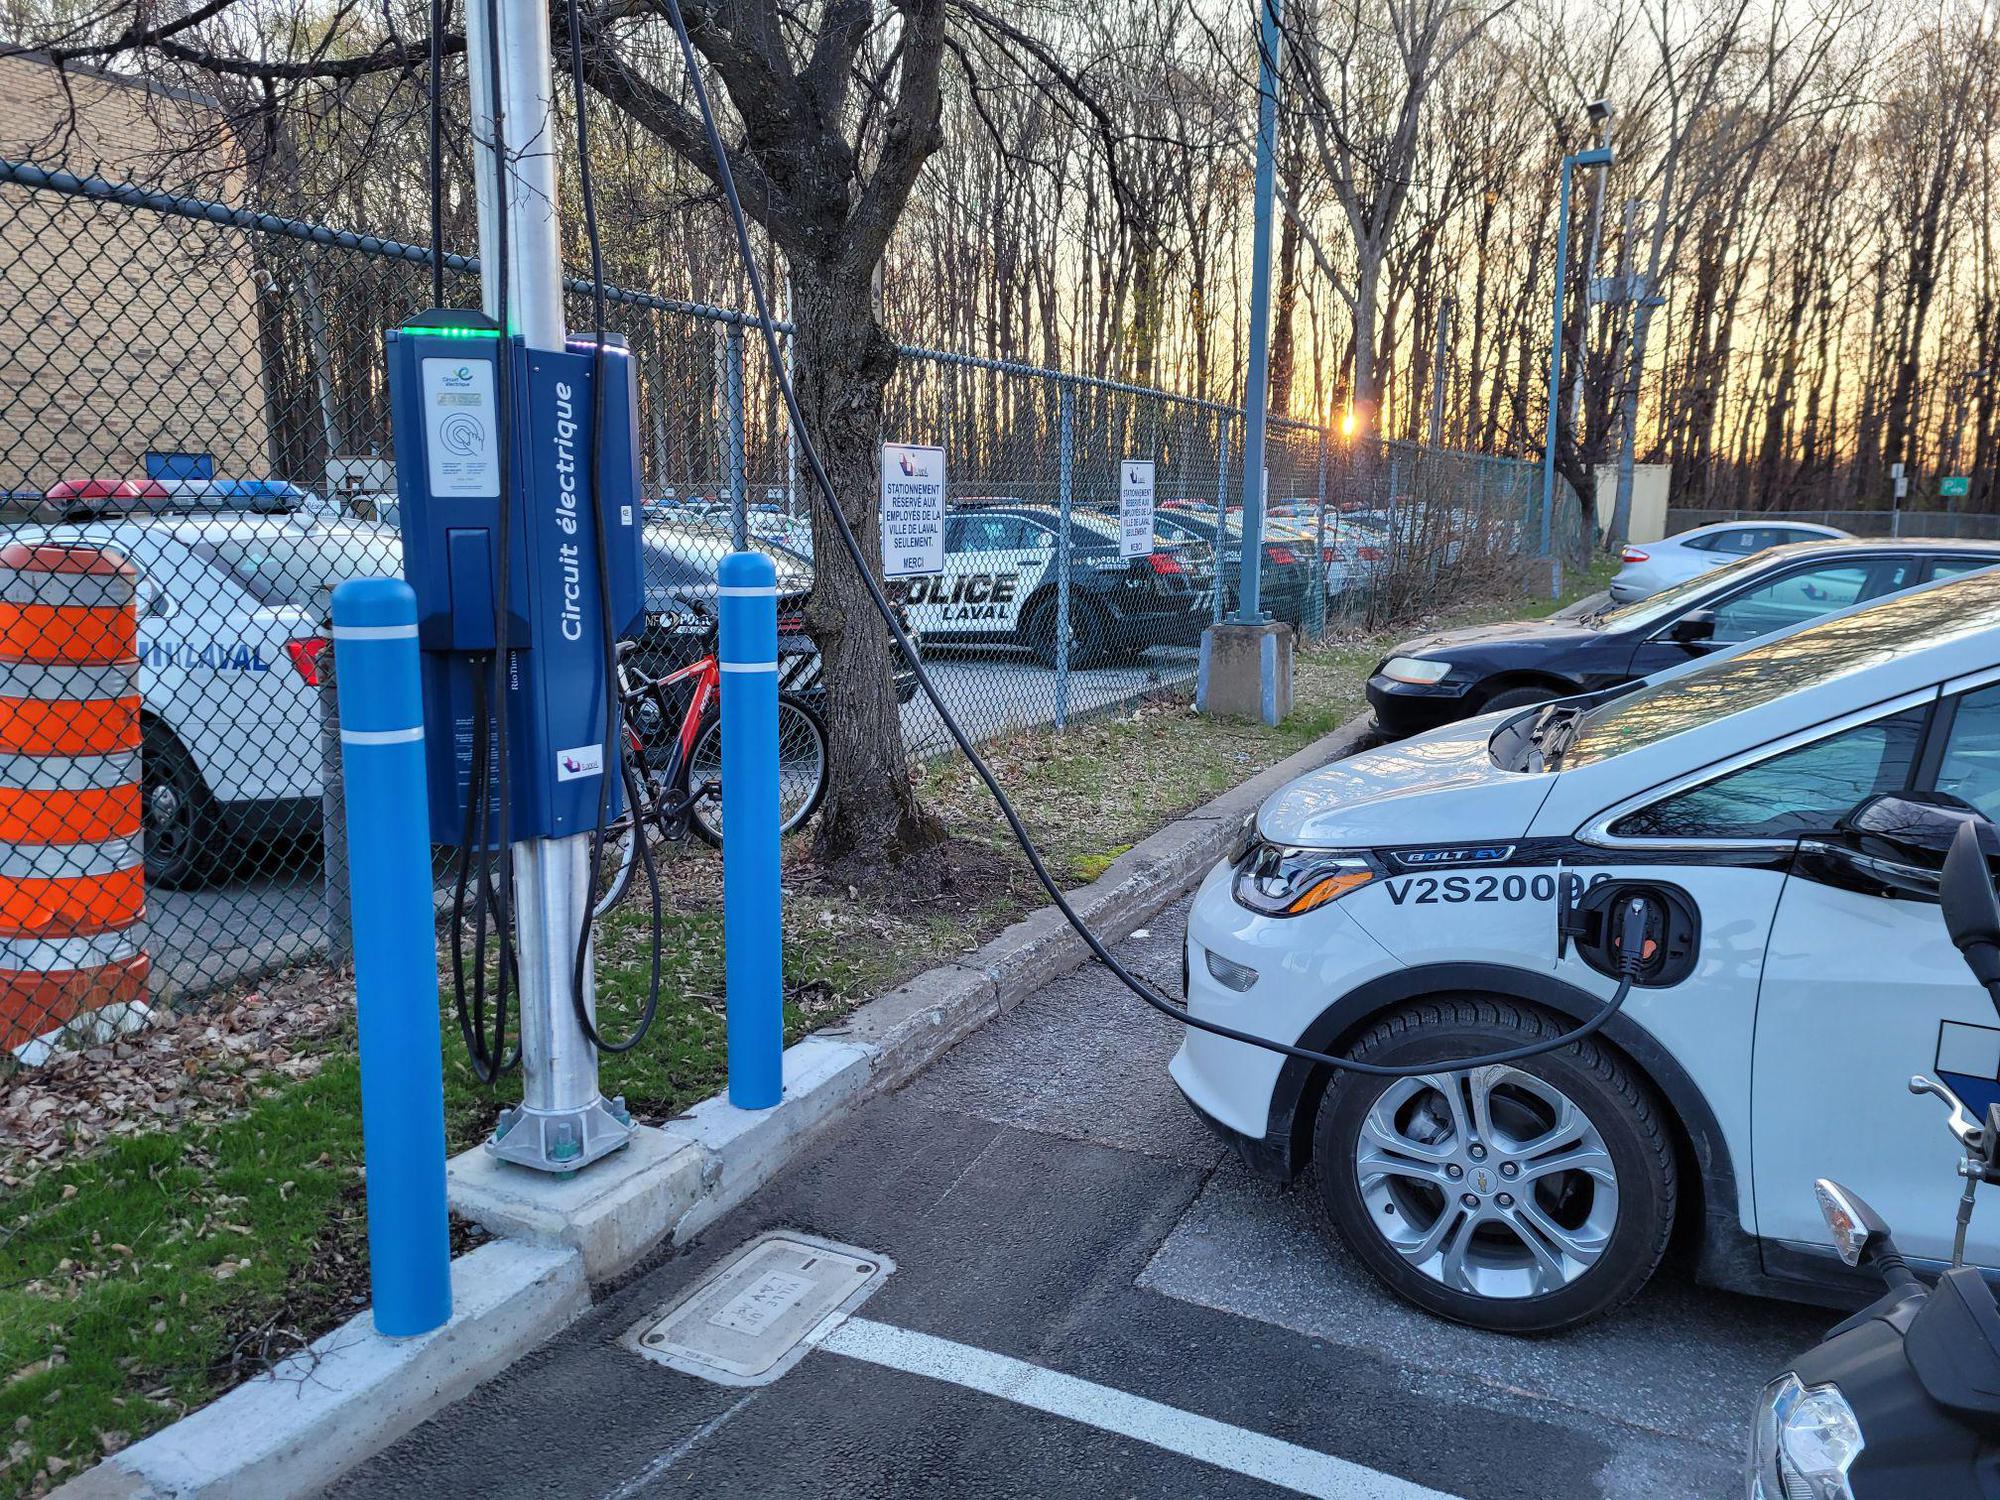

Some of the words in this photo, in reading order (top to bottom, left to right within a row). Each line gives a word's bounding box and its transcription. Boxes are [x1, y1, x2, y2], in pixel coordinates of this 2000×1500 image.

[553, 382, 578, 535] électrique
[887, 483, 940, 495] STATIONNEMENT
[1123, 488, 1152, 498] STATIONNEMENT
[923, 496, 936, 508] AUX
[886, 507, 920, 521] EMPLOYÉS
[922, 510, 932, 521] DE
[933, 511, 941, 520] LA
[889, 524, 907, 535] VILLE
[908, 524, 917, 534] DE
[918, 523, 938, 534] LAVAL
[894, 536, 933, 548] SEULEMENT.
[903, 557, 924, 568] MERCI
[559, 543, 582, 641] Circuit
[904, 574, 1019, 604] OLICE
[942, 605, 1009, 620] LAVAL
[184, 642, 270, 672] LAVAL
[1408, 851, 1469, 862] BOLT
[1475, 849, 1505, 859] EV
[1384, 872, 1613, 906] V2S2009
